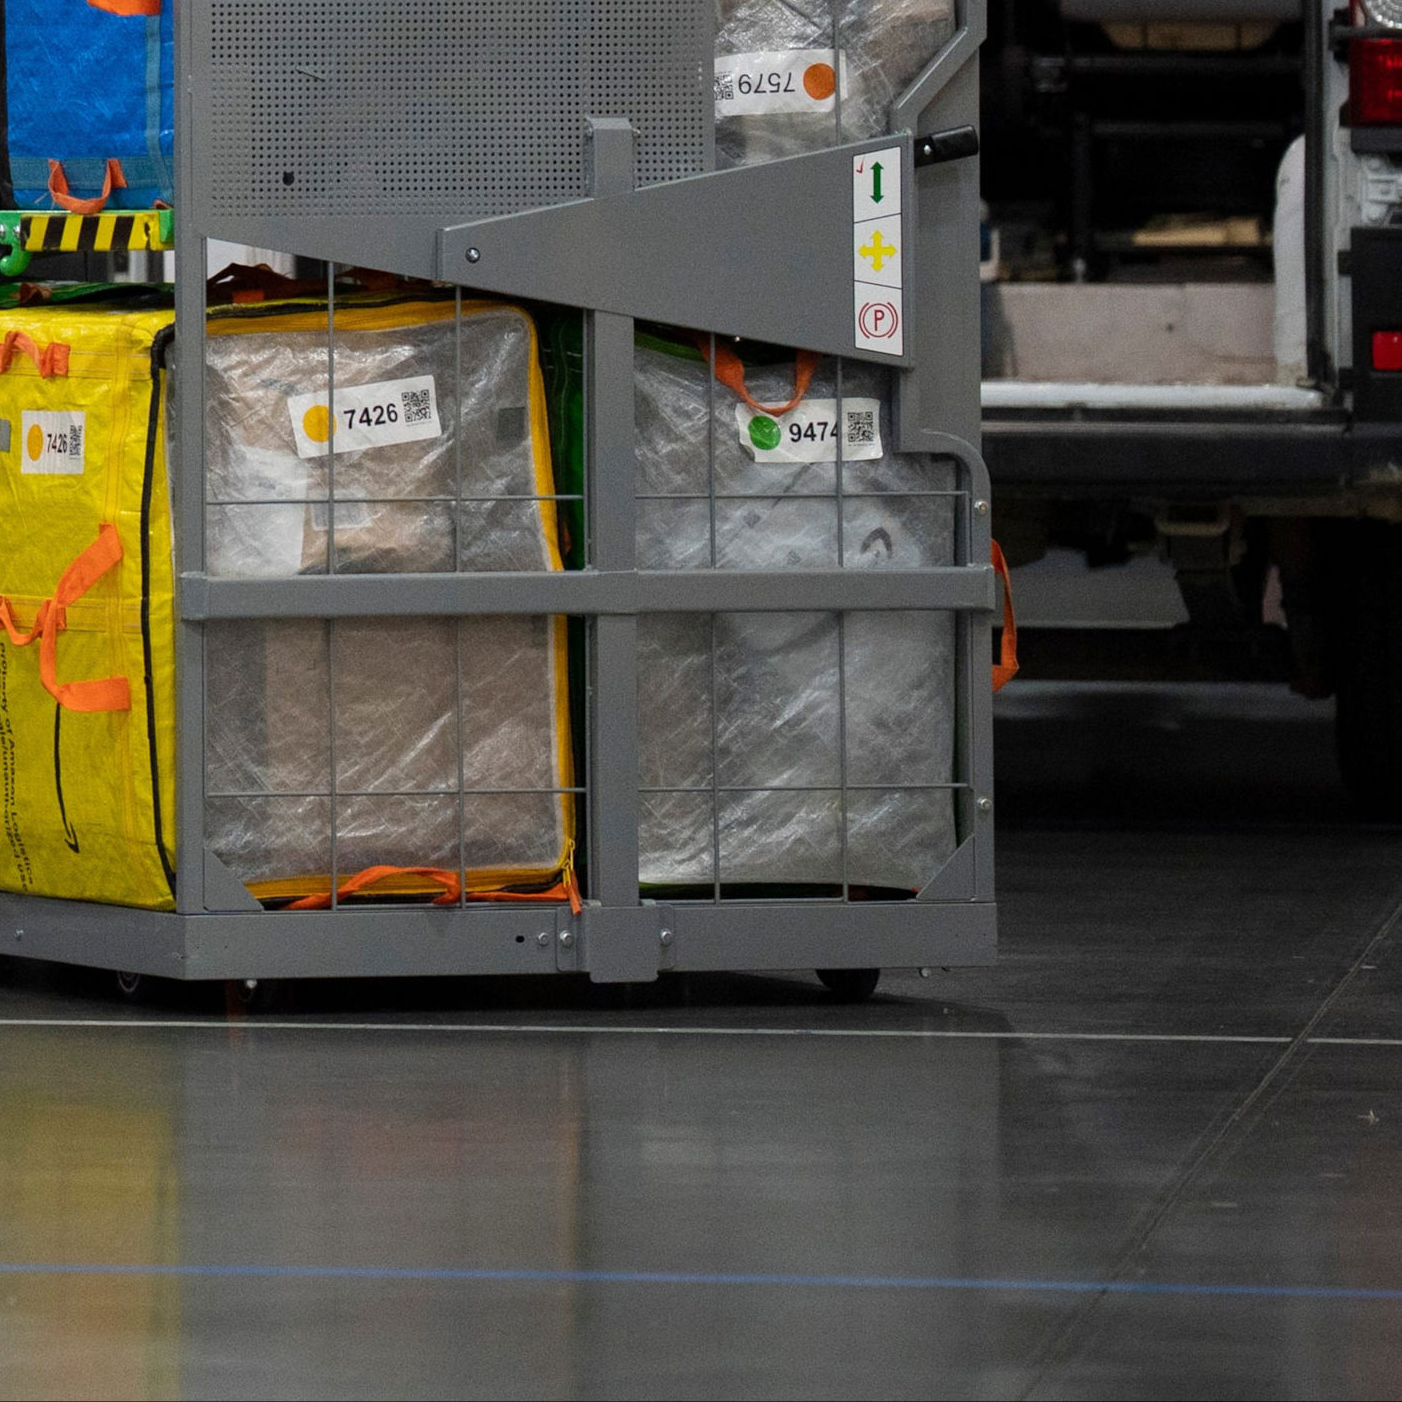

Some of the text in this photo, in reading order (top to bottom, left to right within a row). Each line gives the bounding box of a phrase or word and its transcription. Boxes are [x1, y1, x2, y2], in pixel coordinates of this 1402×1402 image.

[738, 72, 796, 95] 7579
[873, 308, 886, 332] P
[343, 403, 398, 430] 7426
[47, 432, 68, 454] 7426
[8, 737, 16, 806] Amazon
[10, 811, 34, 885] Logistics
